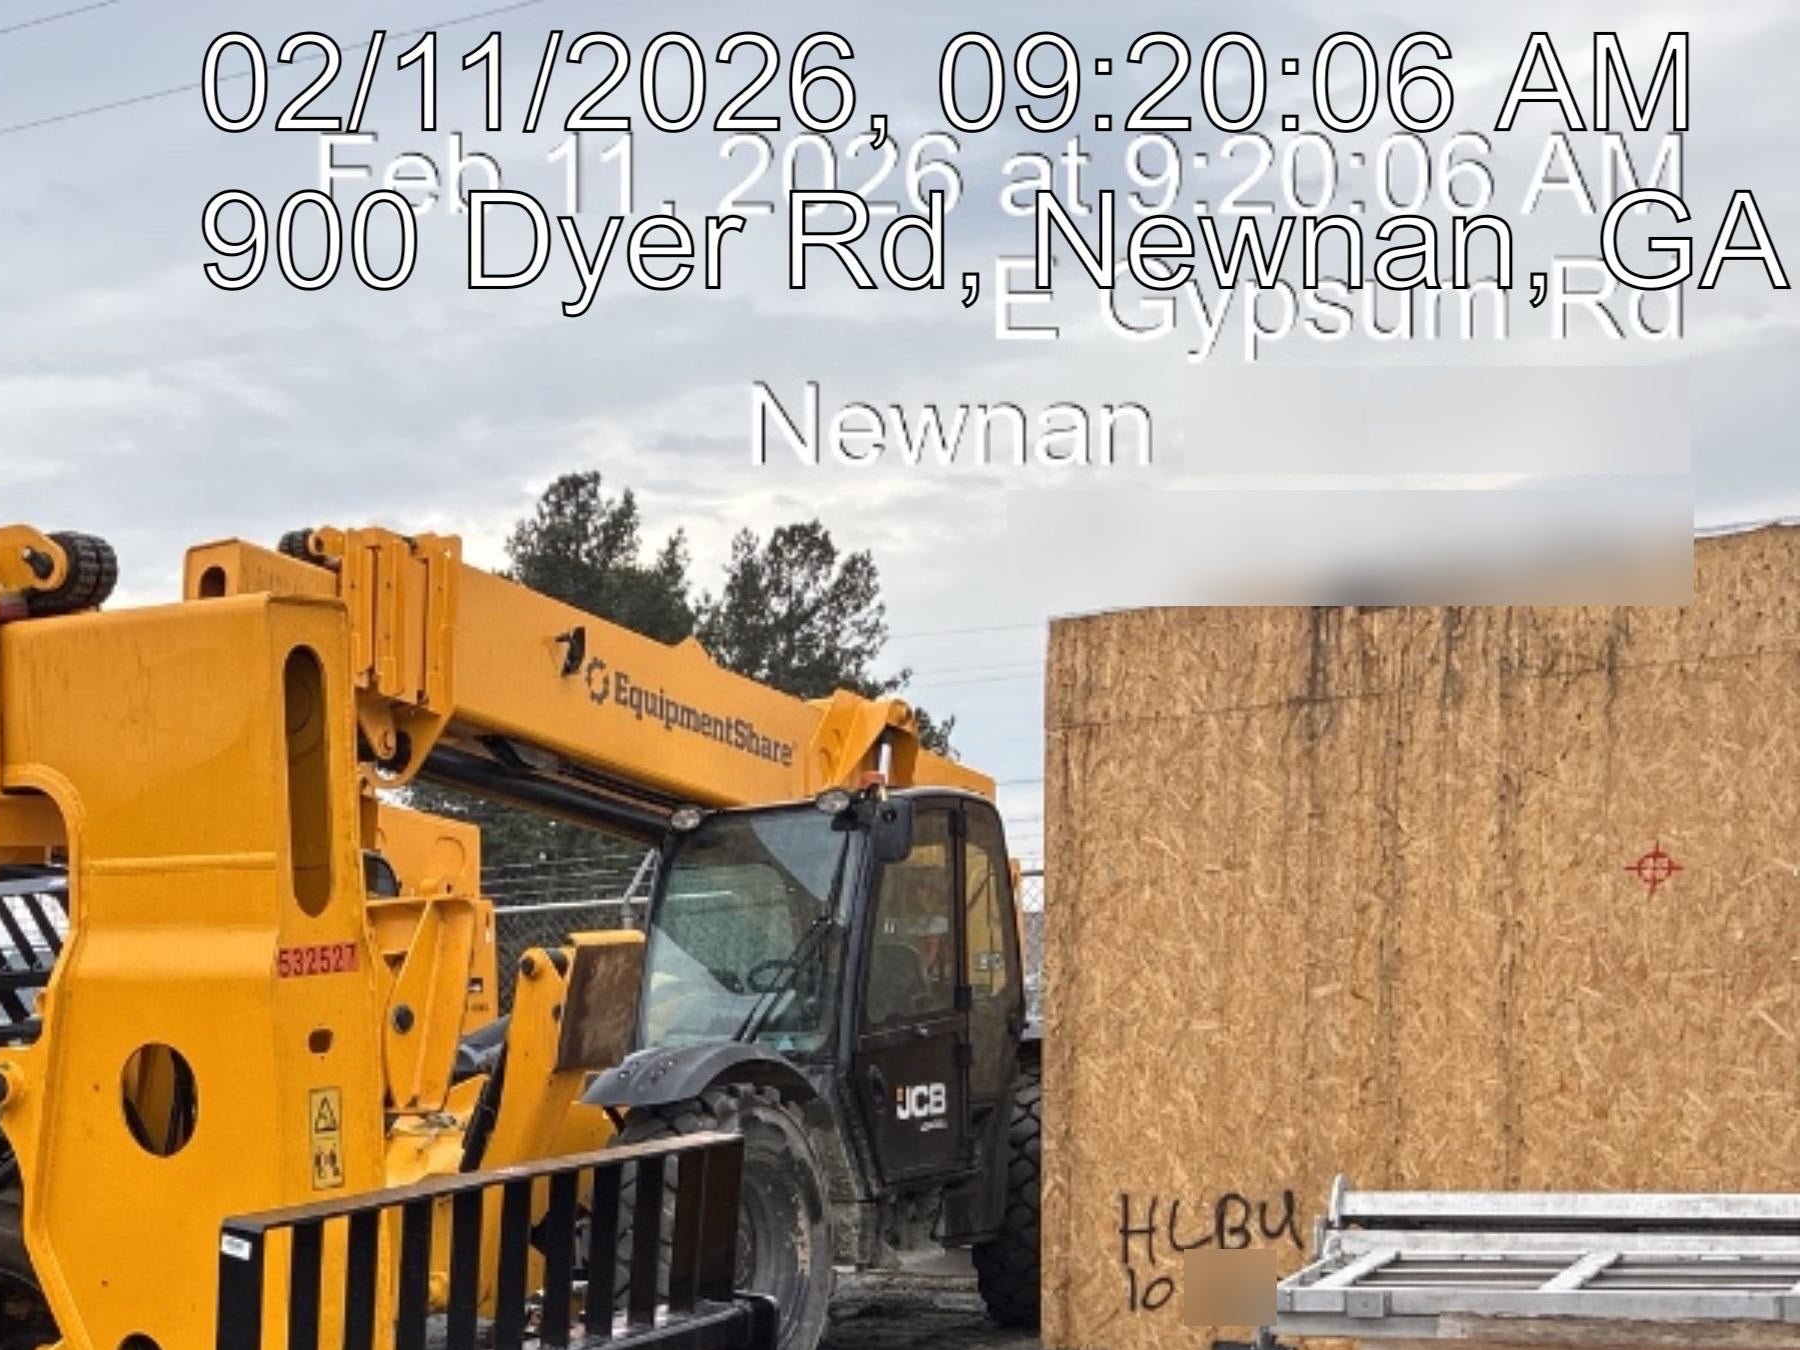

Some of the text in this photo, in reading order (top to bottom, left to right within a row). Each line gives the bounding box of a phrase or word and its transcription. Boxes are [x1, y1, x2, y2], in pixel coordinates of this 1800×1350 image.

[614, 671, 793, 767] EquipmentShare
[278, 943, 357, 978] 532527
[896, 1083, 946, 1120] JCB
